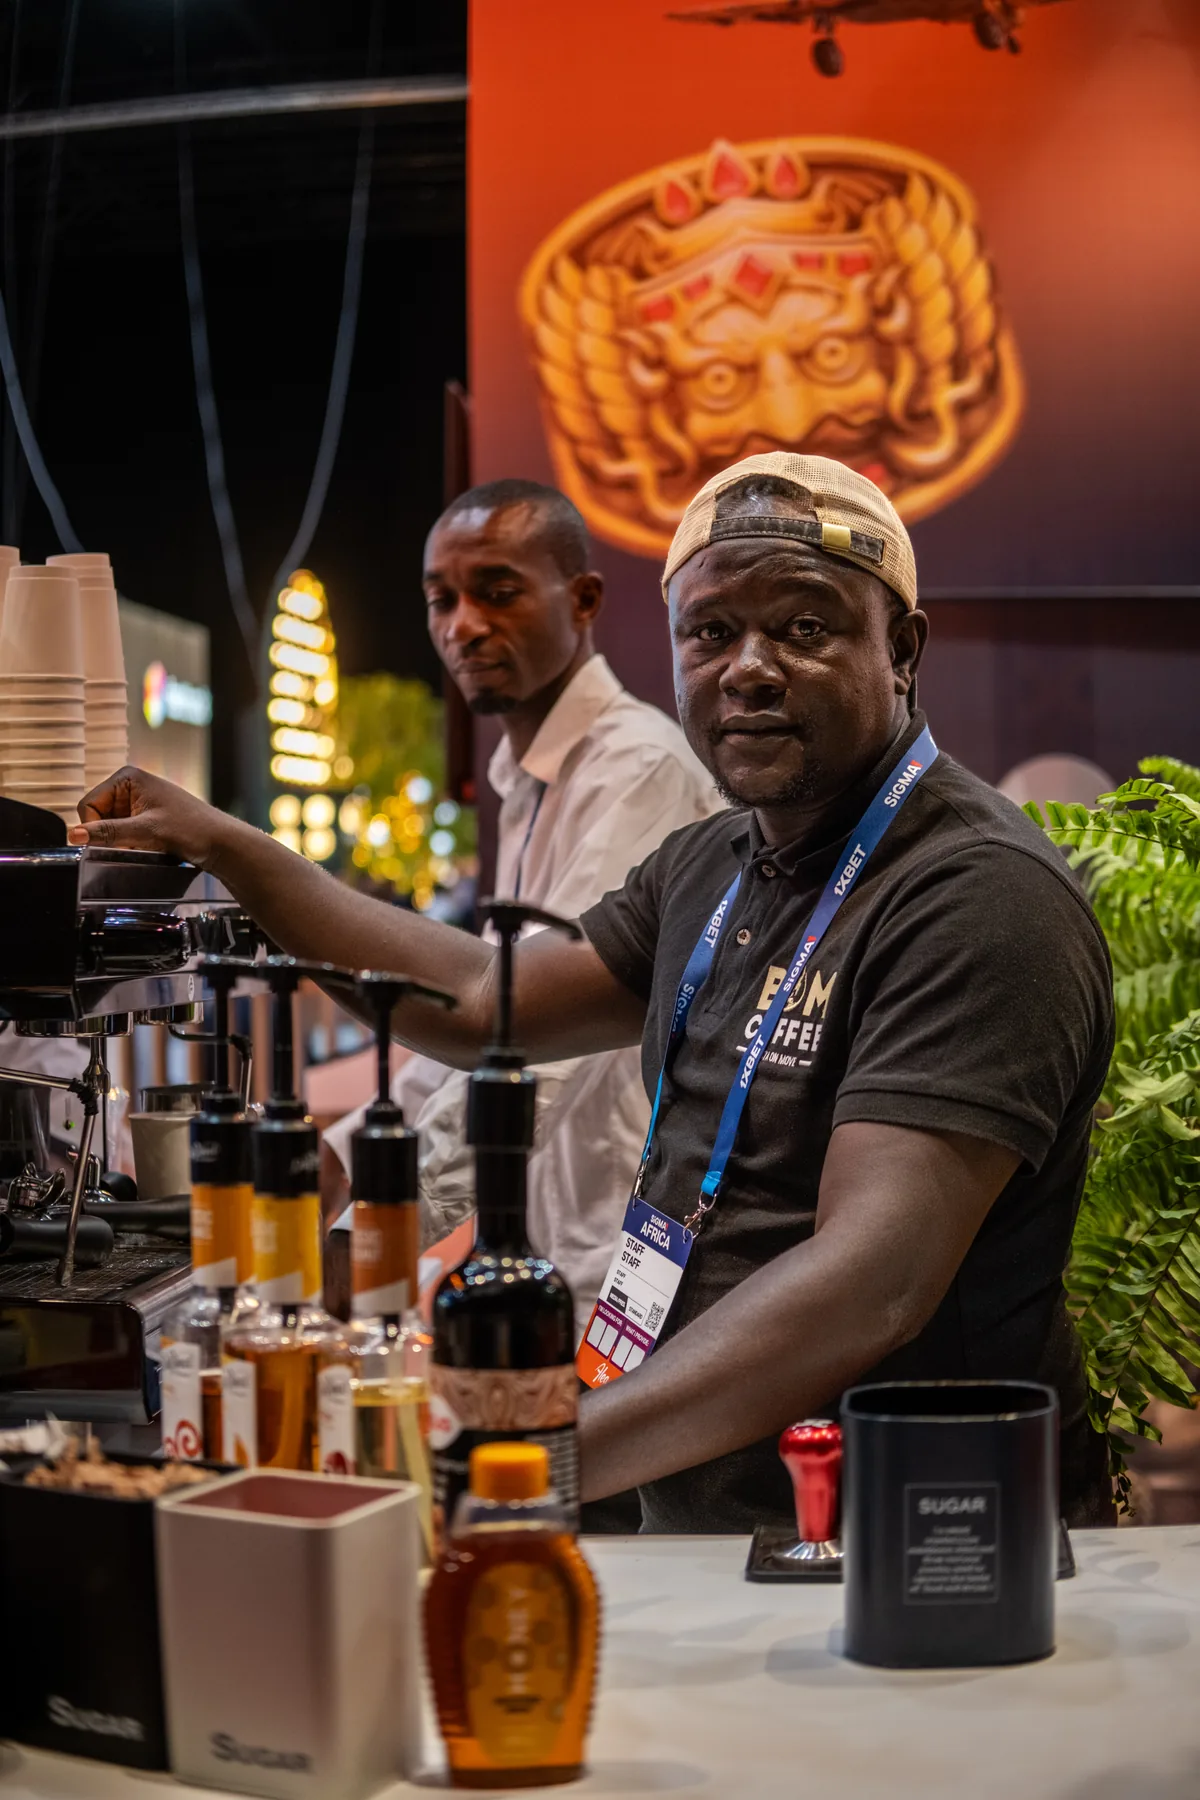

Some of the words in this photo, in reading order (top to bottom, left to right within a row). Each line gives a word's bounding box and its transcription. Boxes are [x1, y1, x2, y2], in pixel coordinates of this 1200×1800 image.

[834, 844, 866, 896] 1XBET
[745, 1014, 822, 1052] CFFEE
[740, 1034, 764, 1089] 1XBET
[778, 1053, 797, 1067] MOVE
[640, 1221, 670, 1250] AFRICA
[626, 1237, 645, 1255] STAFF
[621, 1250, 641, 1269] STAFF
[613, 1277, 624, 1286] STAFF
[616, 1269, 626, 1278] STAFF
[918, 1496, 987, 1515] SUGAR
